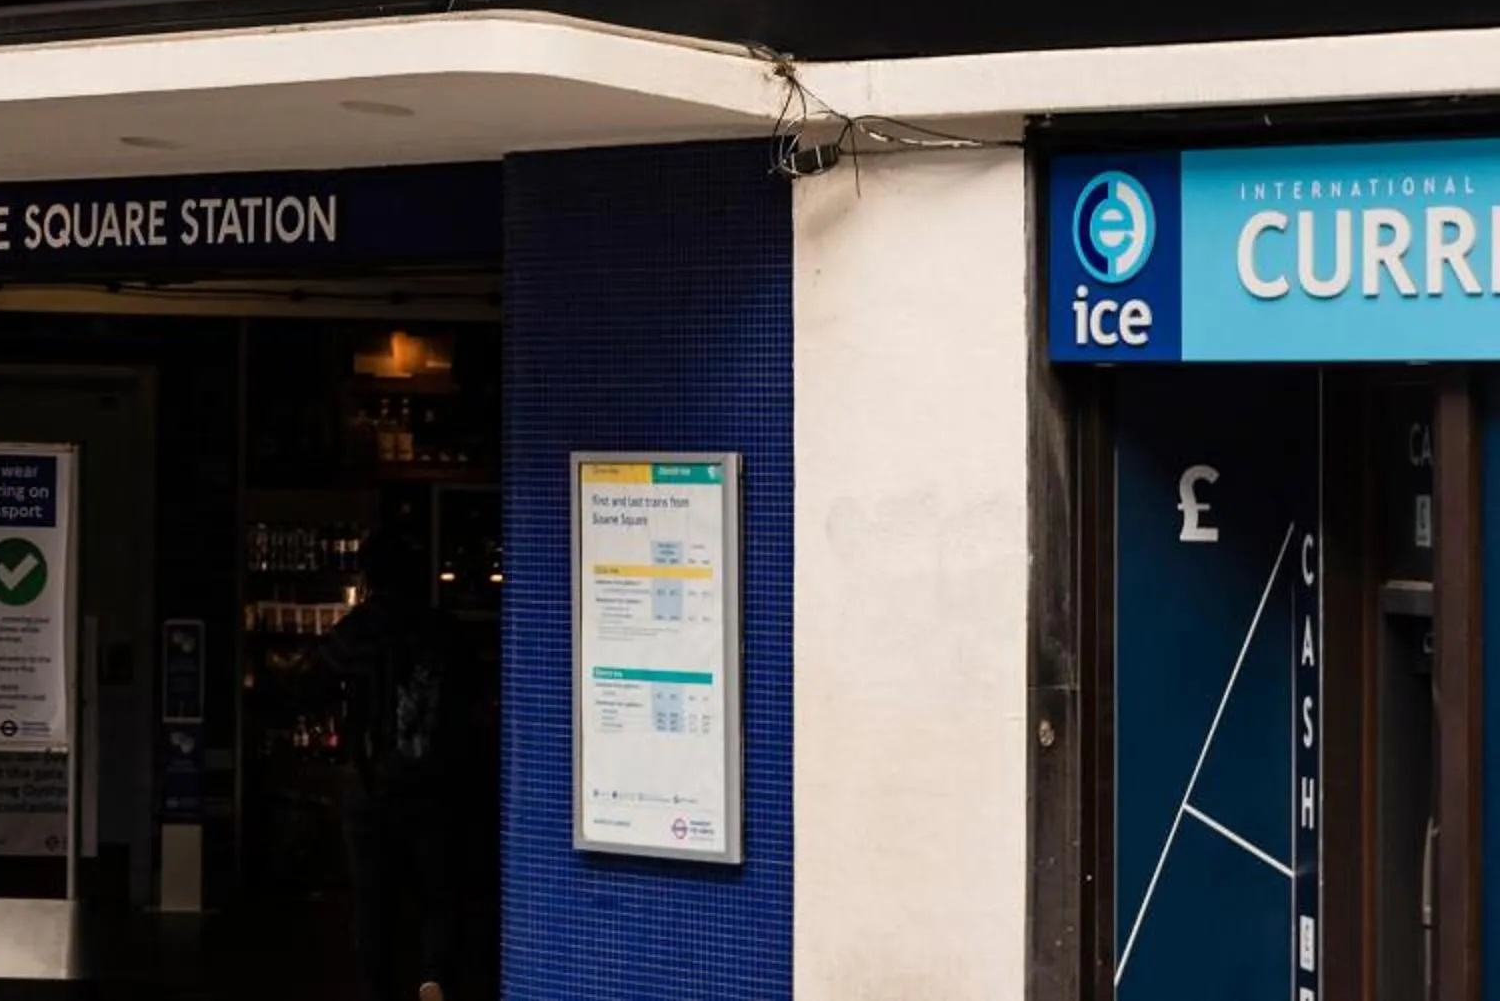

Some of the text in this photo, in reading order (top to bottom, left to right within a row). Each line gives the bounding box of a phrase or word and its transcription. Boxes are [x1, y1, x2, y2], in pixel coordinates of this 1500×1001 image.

[1240, 176, 1475, 200] INTERNATIONAL
[23, 201, 168, 250] SQUARE
[180, 195, 337, 246] STATION
[1237, 205, 1500, 299] CURR
[1072, 285, 1153, 346] ice
[1, 464, 40, 479] wear
[29, 486, 50, 499] on
[1299, 533, 1316, 831] CASH
